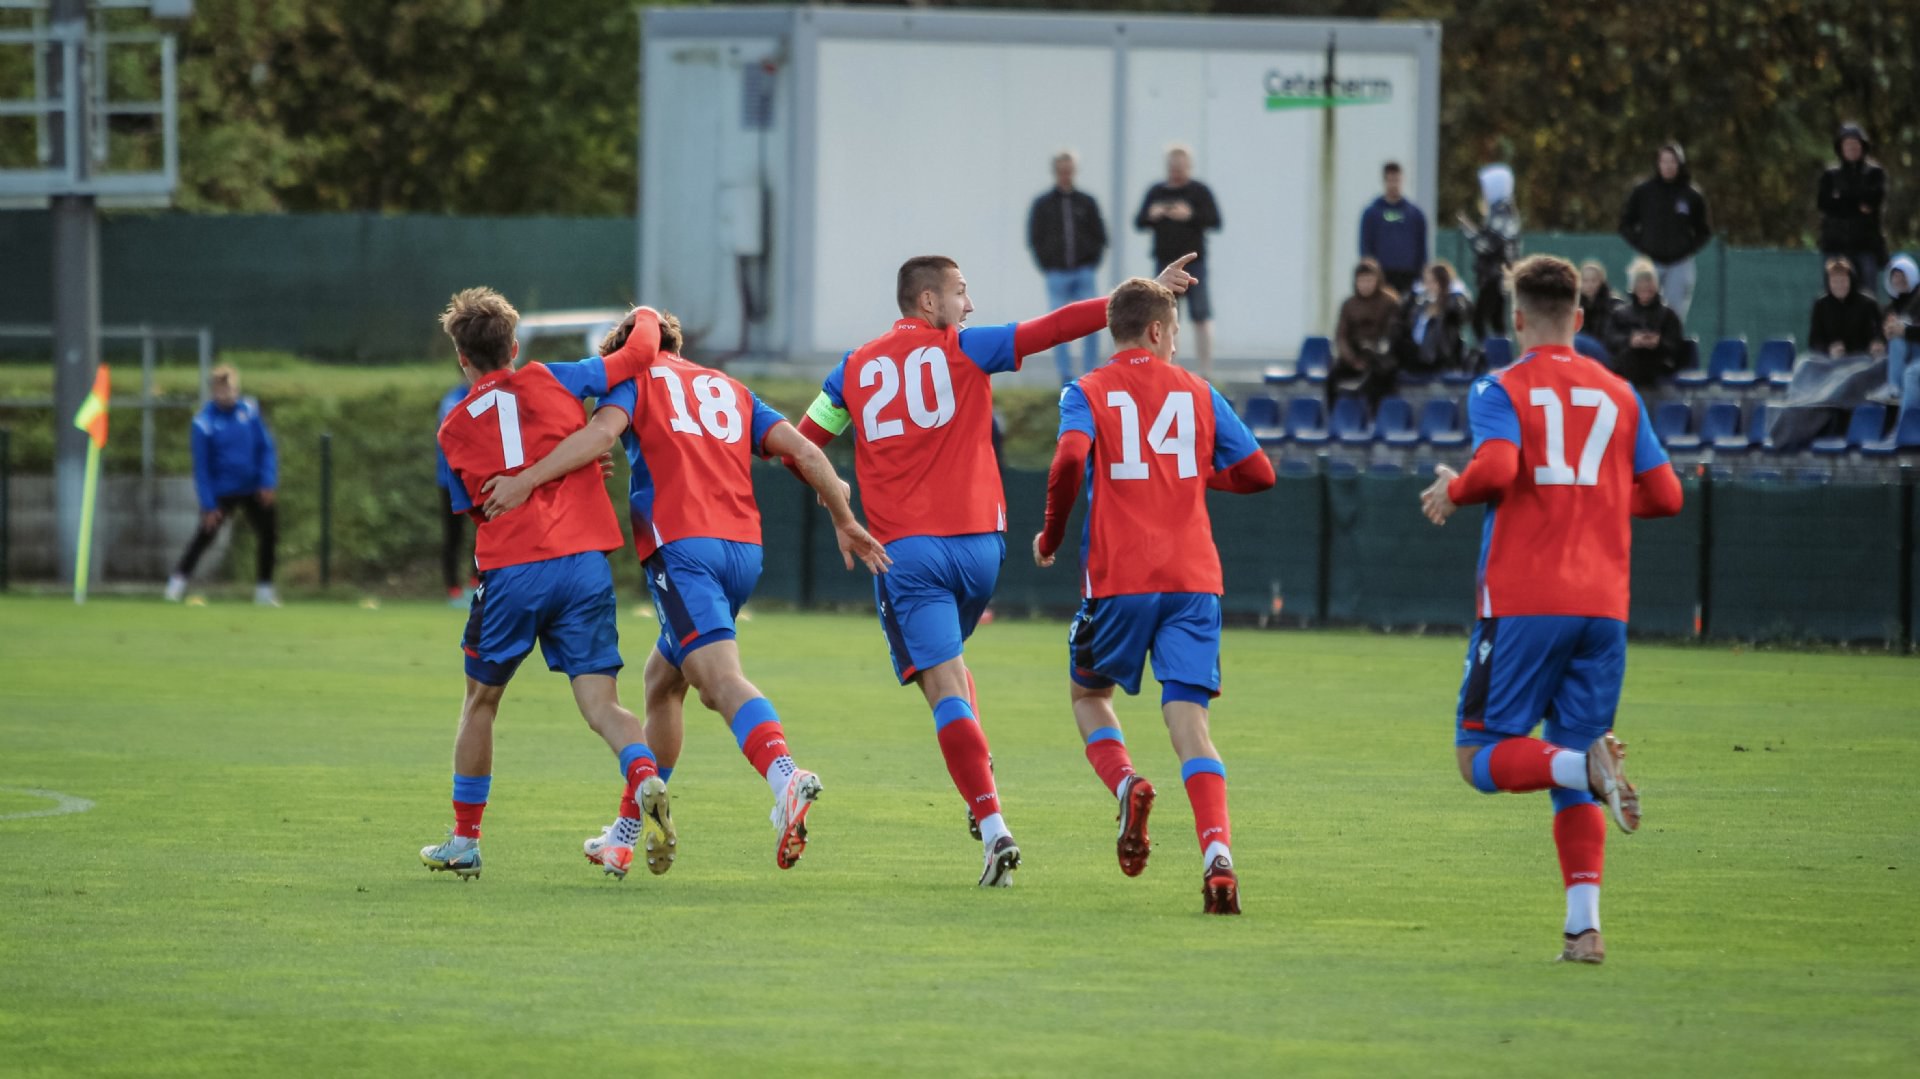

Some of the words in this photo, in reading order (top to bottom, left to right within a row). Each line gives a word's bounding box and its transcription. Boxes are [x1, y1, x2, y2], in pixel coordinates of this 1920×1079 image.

[478, 380, 496, 391] FCVP
[859, 346, 956, 442] 20
[1130, 356, 1150, 365] FCVP
[466, 389, 525, 470] 7
[650, 366, 743, 444] 18
[1107, 391, 1198, 480] 14
[1529, 387, 1619, 486] 17
